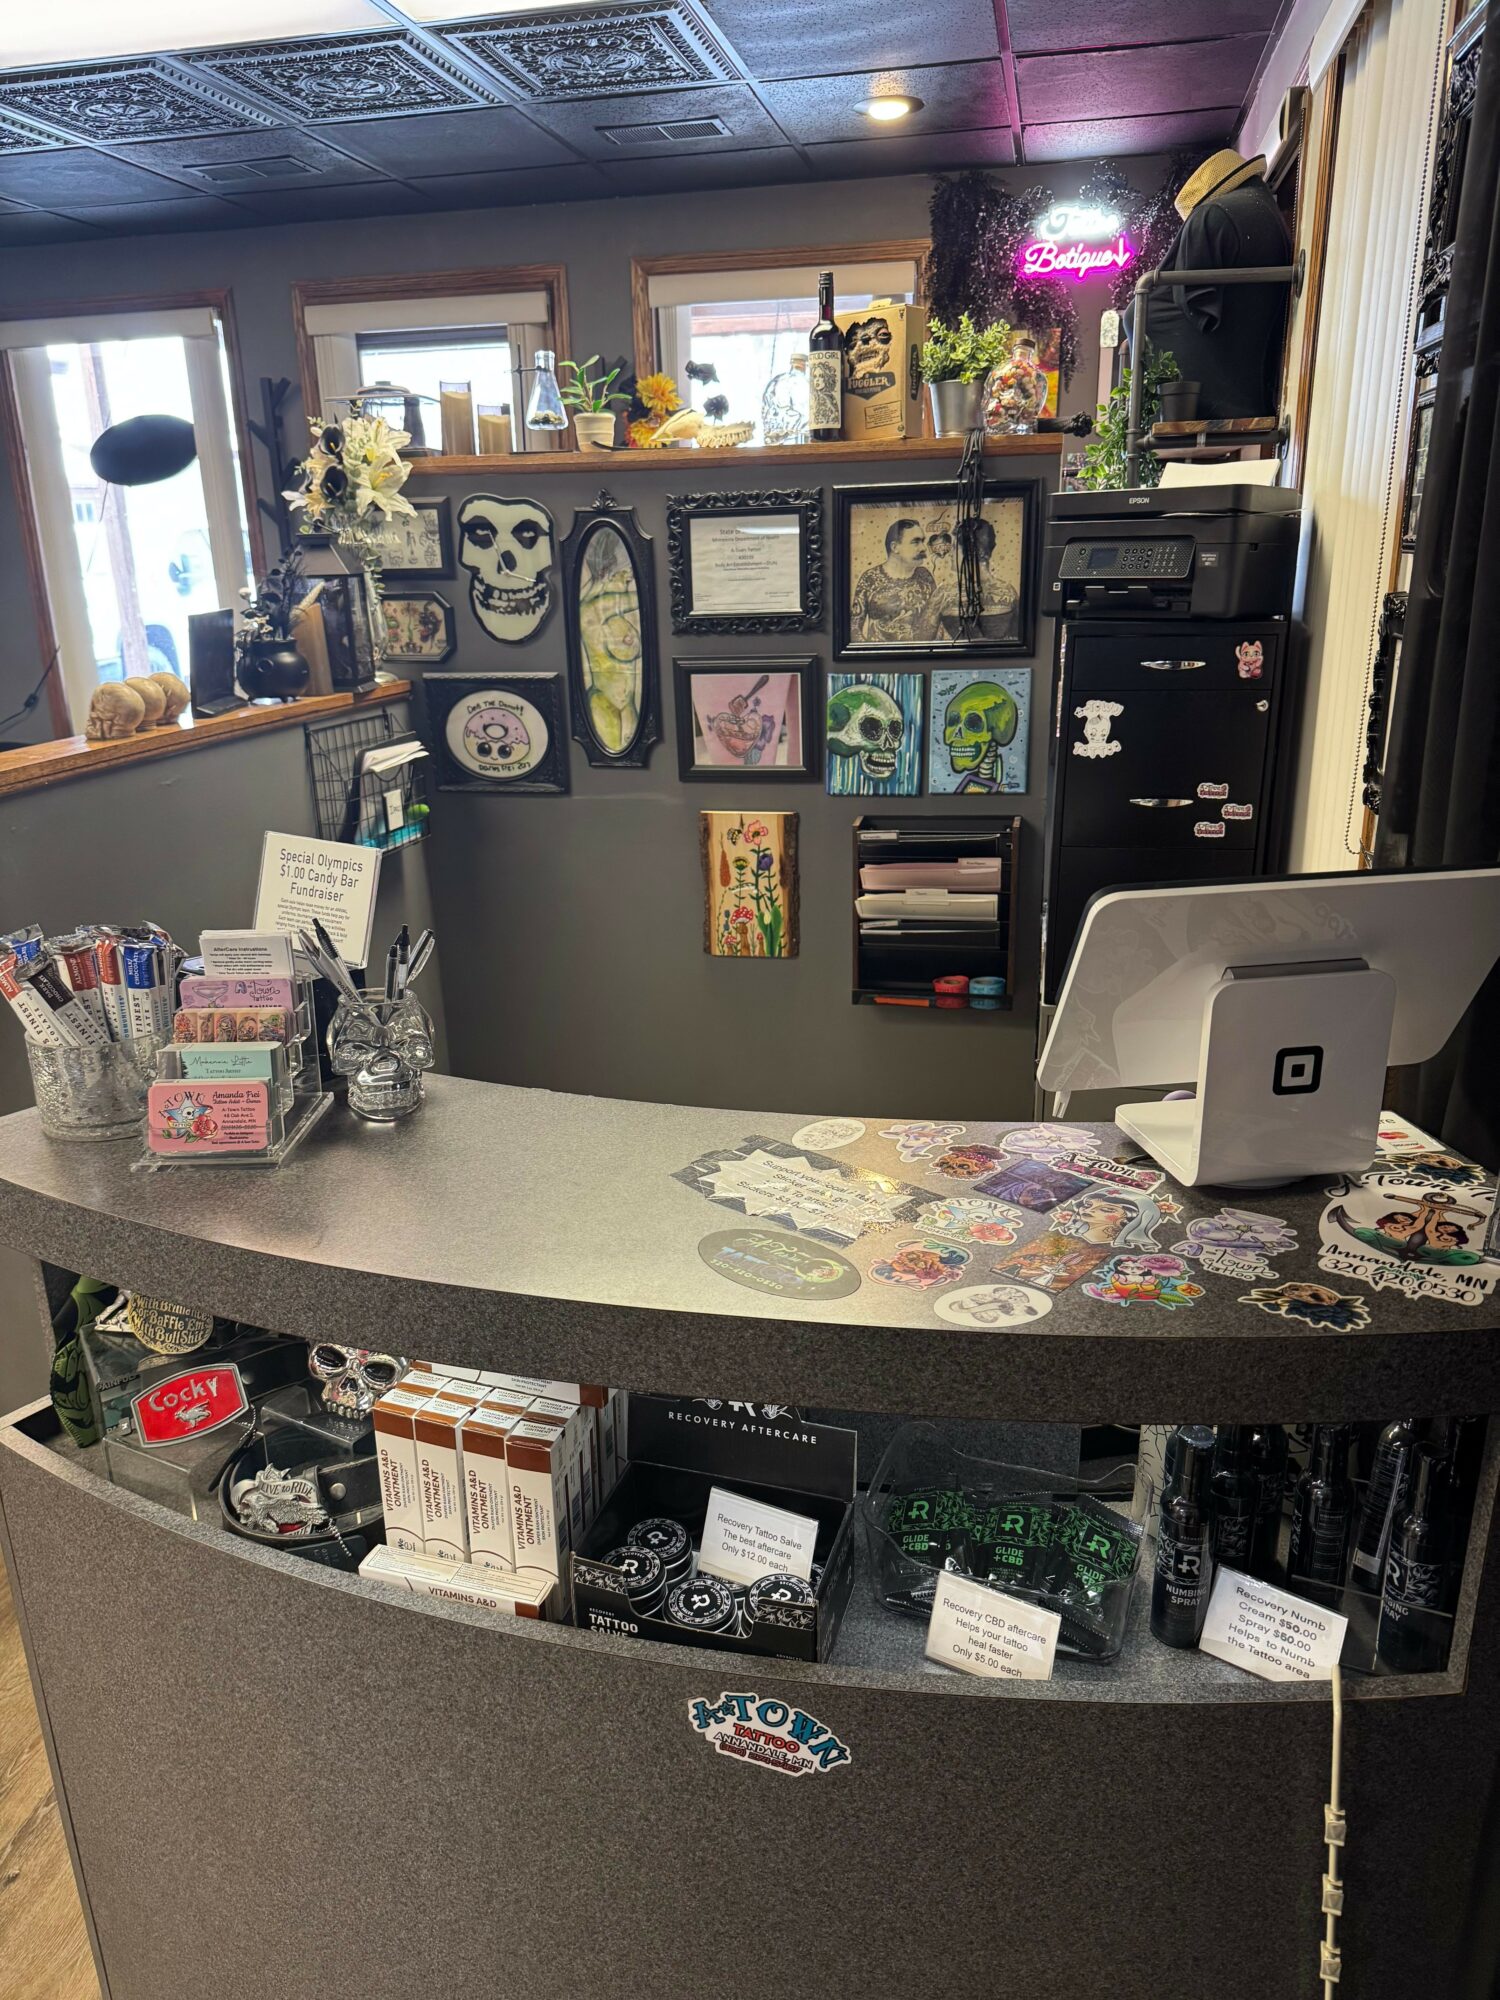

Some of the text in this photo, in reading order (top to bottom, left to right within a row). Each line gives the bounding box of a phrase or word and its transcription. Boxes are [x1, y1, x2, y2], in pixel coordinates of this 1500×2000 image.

[1024, 242, 1113, 277] Botique
[280, 848, 363, 872] Special Olympics
[280, 864, 359, 888] $1.00 Candy Bar
[290, 882, 344, 902] Fundraiser
[0, 974, 13, 994] ALMO
[65, 1012, 96, 1046] FINEST
[134, 995, 143, 1033] FINEST
[213, 1091, 244, 1099] Amanda
[763, 1160, 803, 1178] Support
[1328, 1172, 1456, 1197] A-Town
[737, 1181, 775, 1198] Stickers
[1325, 1258, 1476, 1302] 320.420.0530
[1326, 1244, 1488, 1290] Annandale, MN
[150, 1376, 219, 1411] Cocky
[668, 1411, 817, 1445] RECOVERY AFTERCARE
[260, 1481, 314, 1497] LIVE to RIDE
[381, 1449, 394, 1511] VITAMINS A&D
[390, 1459, 402, 1507] OINTMENT
[422, 1459, 434, 1522] VITAMINS A&D
[432, 1470, 442, 1518] OINTMENT
[469, 1470, 480, 1534] VITAMINS A&D
[479, 1480, 489, 1529] OINTMENT
[513, 1485, 525, 1550] VITAMINS A&D
[524, 1496, 534, 1545] OINTMENT
[717, 1513, 802, 1550] Recovery Tattoo Salve
[723, 1529, 792, 1560] The best aftercare
[902, 1534, 929, 1544] GLIDE
[995, 1546, 1024, 1558] GLIDE
[722, 1542, 788, 1573] Only $12.00 each
[1076, 1563, 1105, 1582] GLIDE
[428, 1586, 496, 1608] VITAMINS A&D
[1165, 1584, 1207, 1597] NUMBING
[1171, 1596, 1202, 1605] SPRAY
[588, 1613, 639, 1634] TATTOO
[943, 1597, 1047, 1645] Recovery CBD aftercare
[1236, 1586, 1326, 1631] Recovery Numb
[1238, 1614, 1271, 1634] Spray
[1239, 1602, 1317, 1641] Cream $50.00
[955, 1617, 1028, 1652] Helps your tattoo
[968, 1636, 1013, 1660] heal faster
[1228, 1623, 1315, 1668] Helps to Numb
[952, 1644, 1022, 1678] Only $5.00 each
[1227, 1635, 1310, 1679] the Tattoo area
[713, 1732, 791, 1763] ANNANDALE,
[791, 1756, 813, 1770] MN
[732, 1722, 802, 1754] TATTOO
